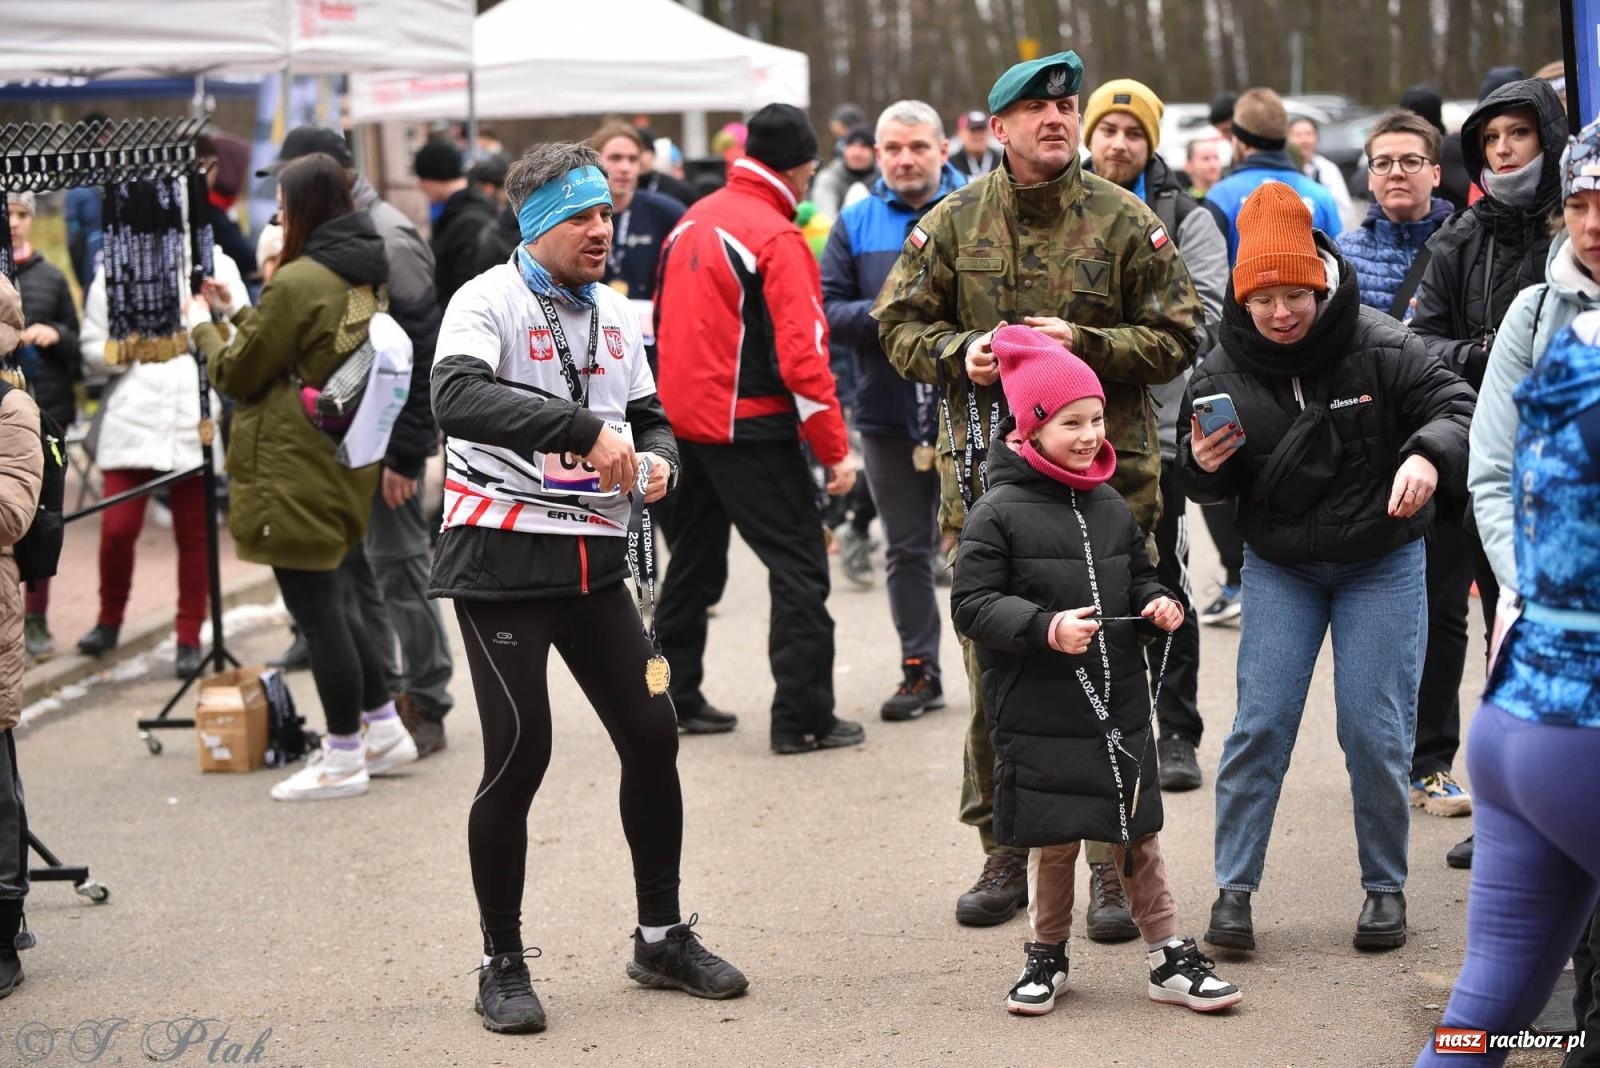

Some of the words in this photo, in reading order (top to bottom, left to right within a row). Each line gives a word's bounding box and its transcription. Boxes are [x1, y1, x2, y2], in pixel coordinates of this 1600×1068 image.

[538, 294, 568, 349] 3.02.2025
[1330, 398, 1359, 410] ellesse
[968, 392, 984, 449] 23.02.2025
[965, 468, 971, 477] 13
[641, 508, 653, 575] TWARDZIELA
[1084, 541, 1093, 566] COOL
[1088, 566, 1096, 580] SO
[1098, 629, 1107, 655] COOL
[1102, 655, 1110, 669] SO
[1104, 669, 1111, 679] IS
[1075, 666, 1110, 721] 23.02.2025
[1112, 764, 1123, 788] LOVE
[1119, 801, 1127, 827] COOL
